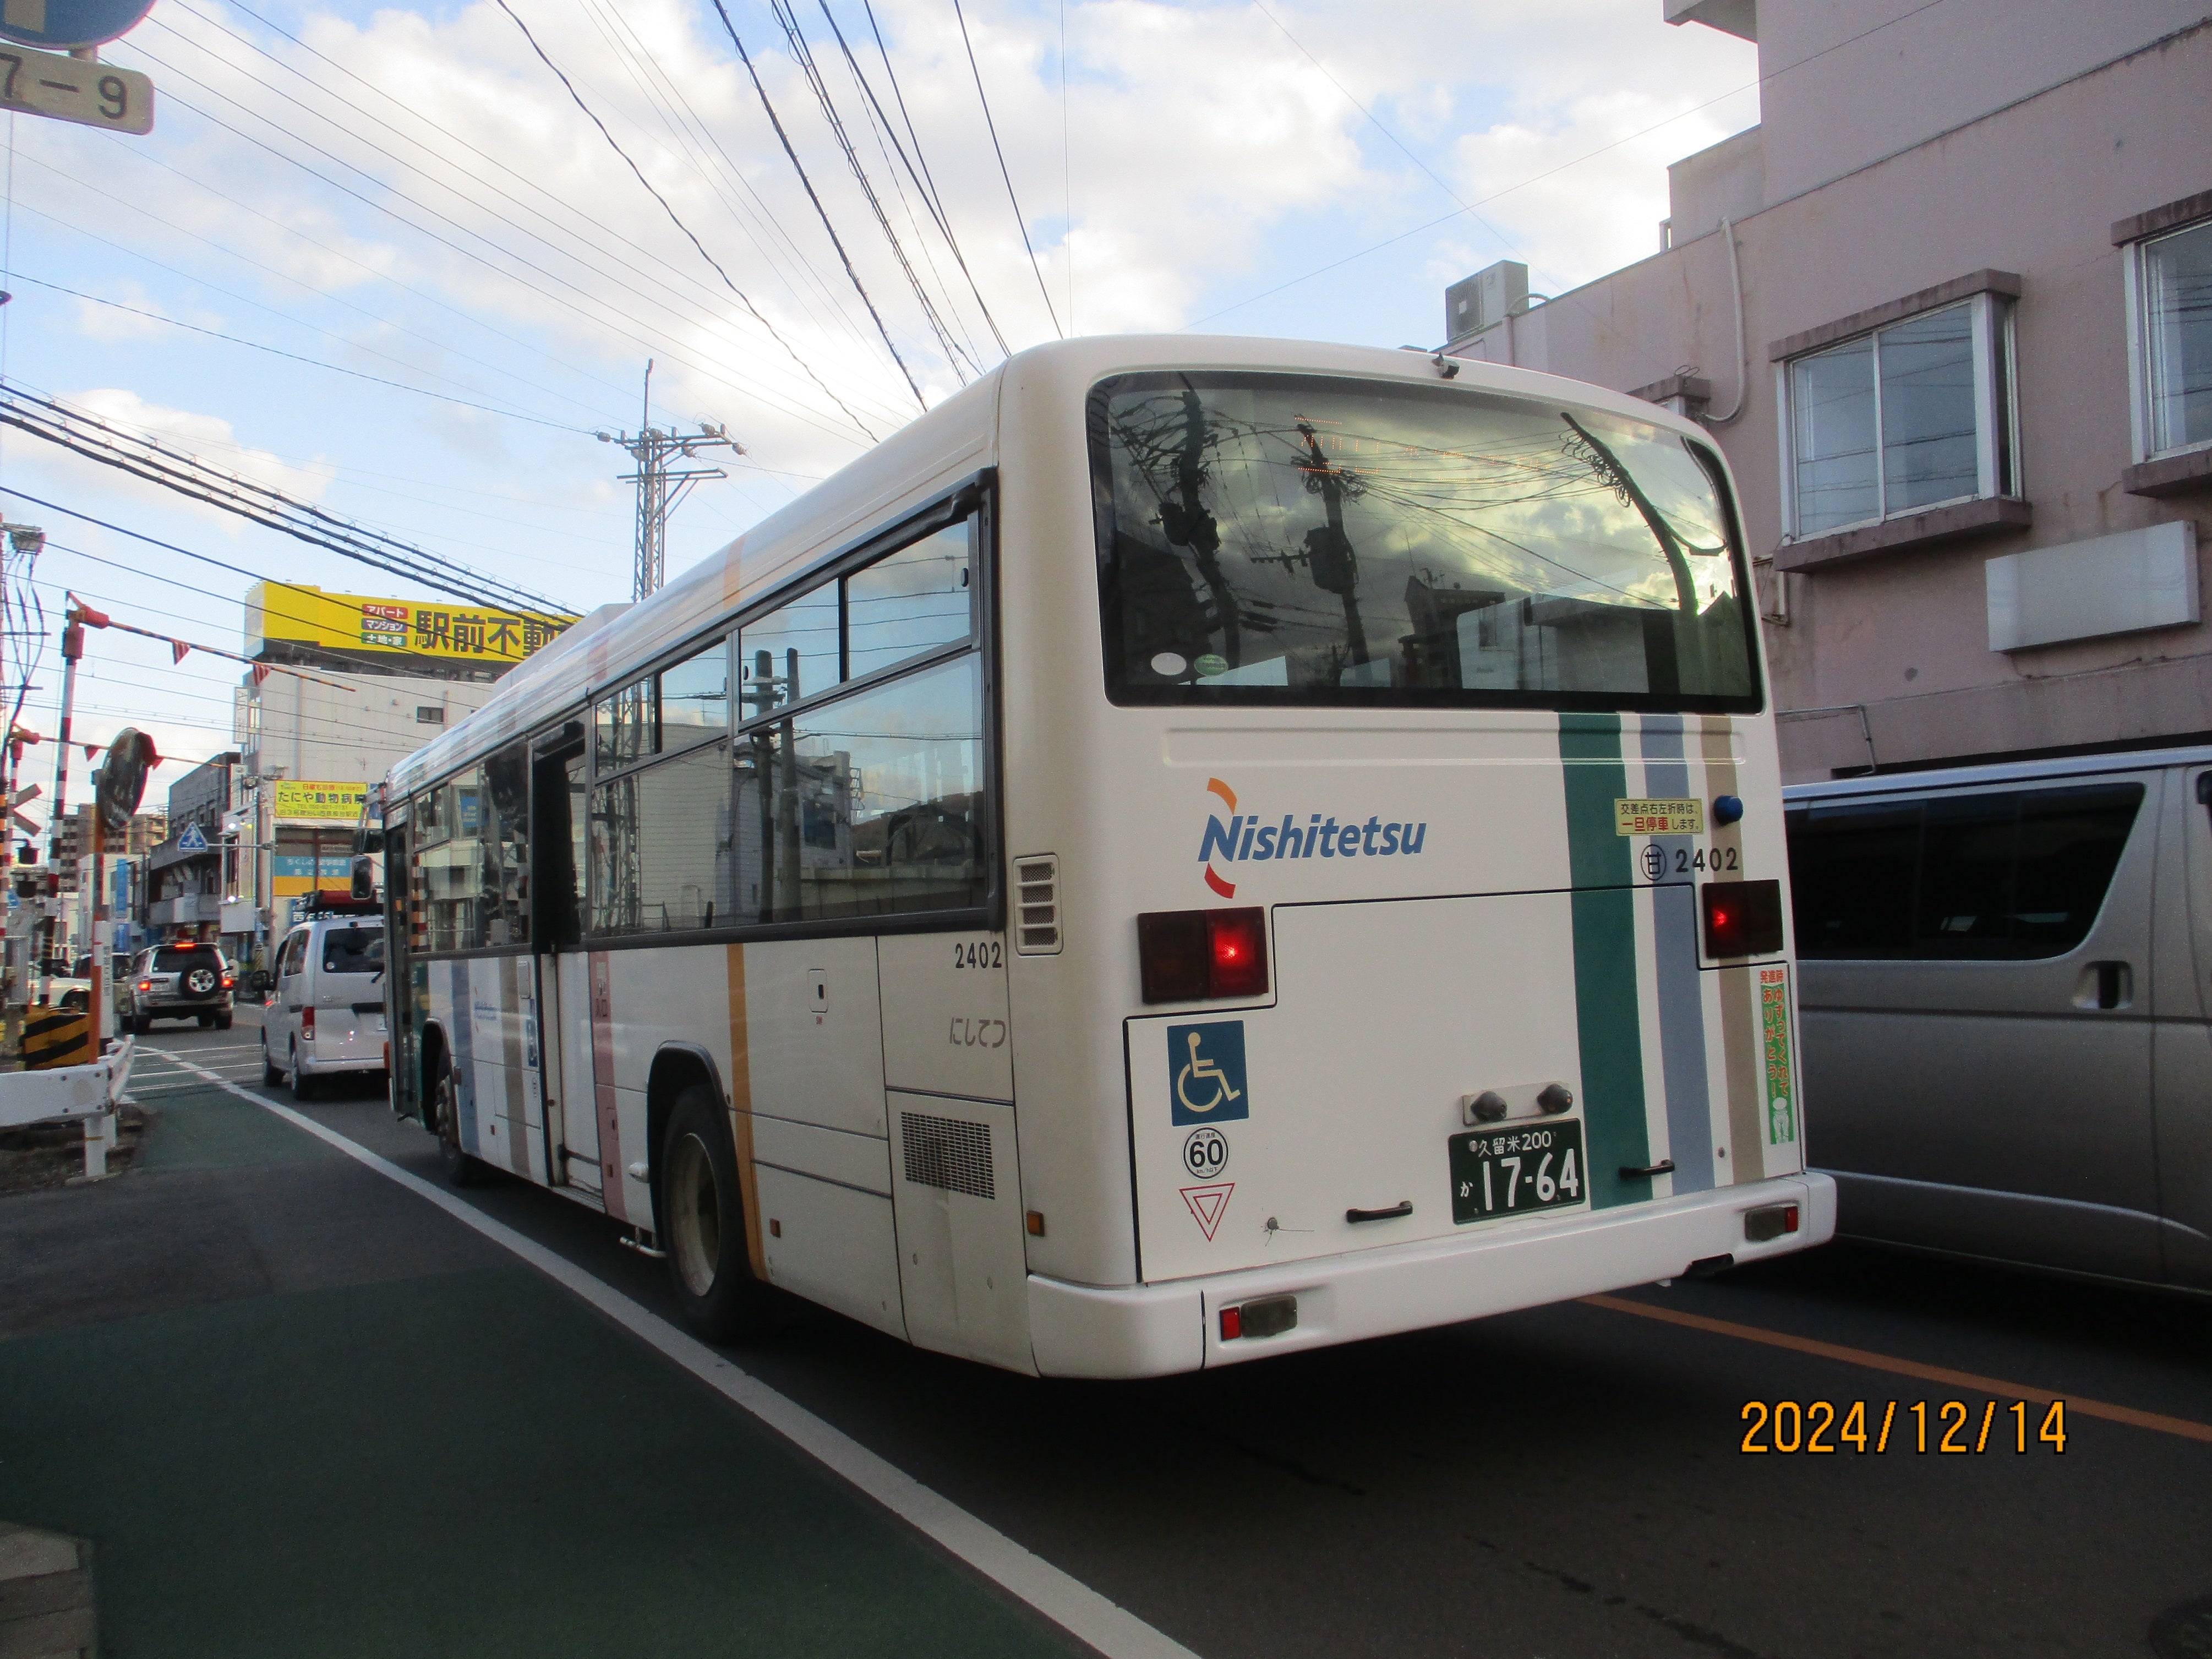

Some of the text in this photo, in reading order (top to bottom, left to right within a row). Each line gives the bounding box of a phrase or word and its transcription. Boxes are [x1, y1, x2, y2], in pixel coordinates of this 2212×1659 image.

[366, 605, 404, 618] アパート
[366, 620, 403, 631] マンション
[1620, 803, 1698, 815] 交差点右左折時は、
[1197, 813, 1427, 863] Nishitetsu
[1621, 816, 1699, 832] 一旦停車します。
[1675, 847, 1739, 873] 2402
[954, 941, 1002, 969] 2402
[949, 1017, 1007, 1049] にしてつ
[1774, 988, 1788, 1096] ゆずってくれて
[1189, 1139, 1224, 1168] 60
[1460, 1148, 1579, 1211] か 17-64
